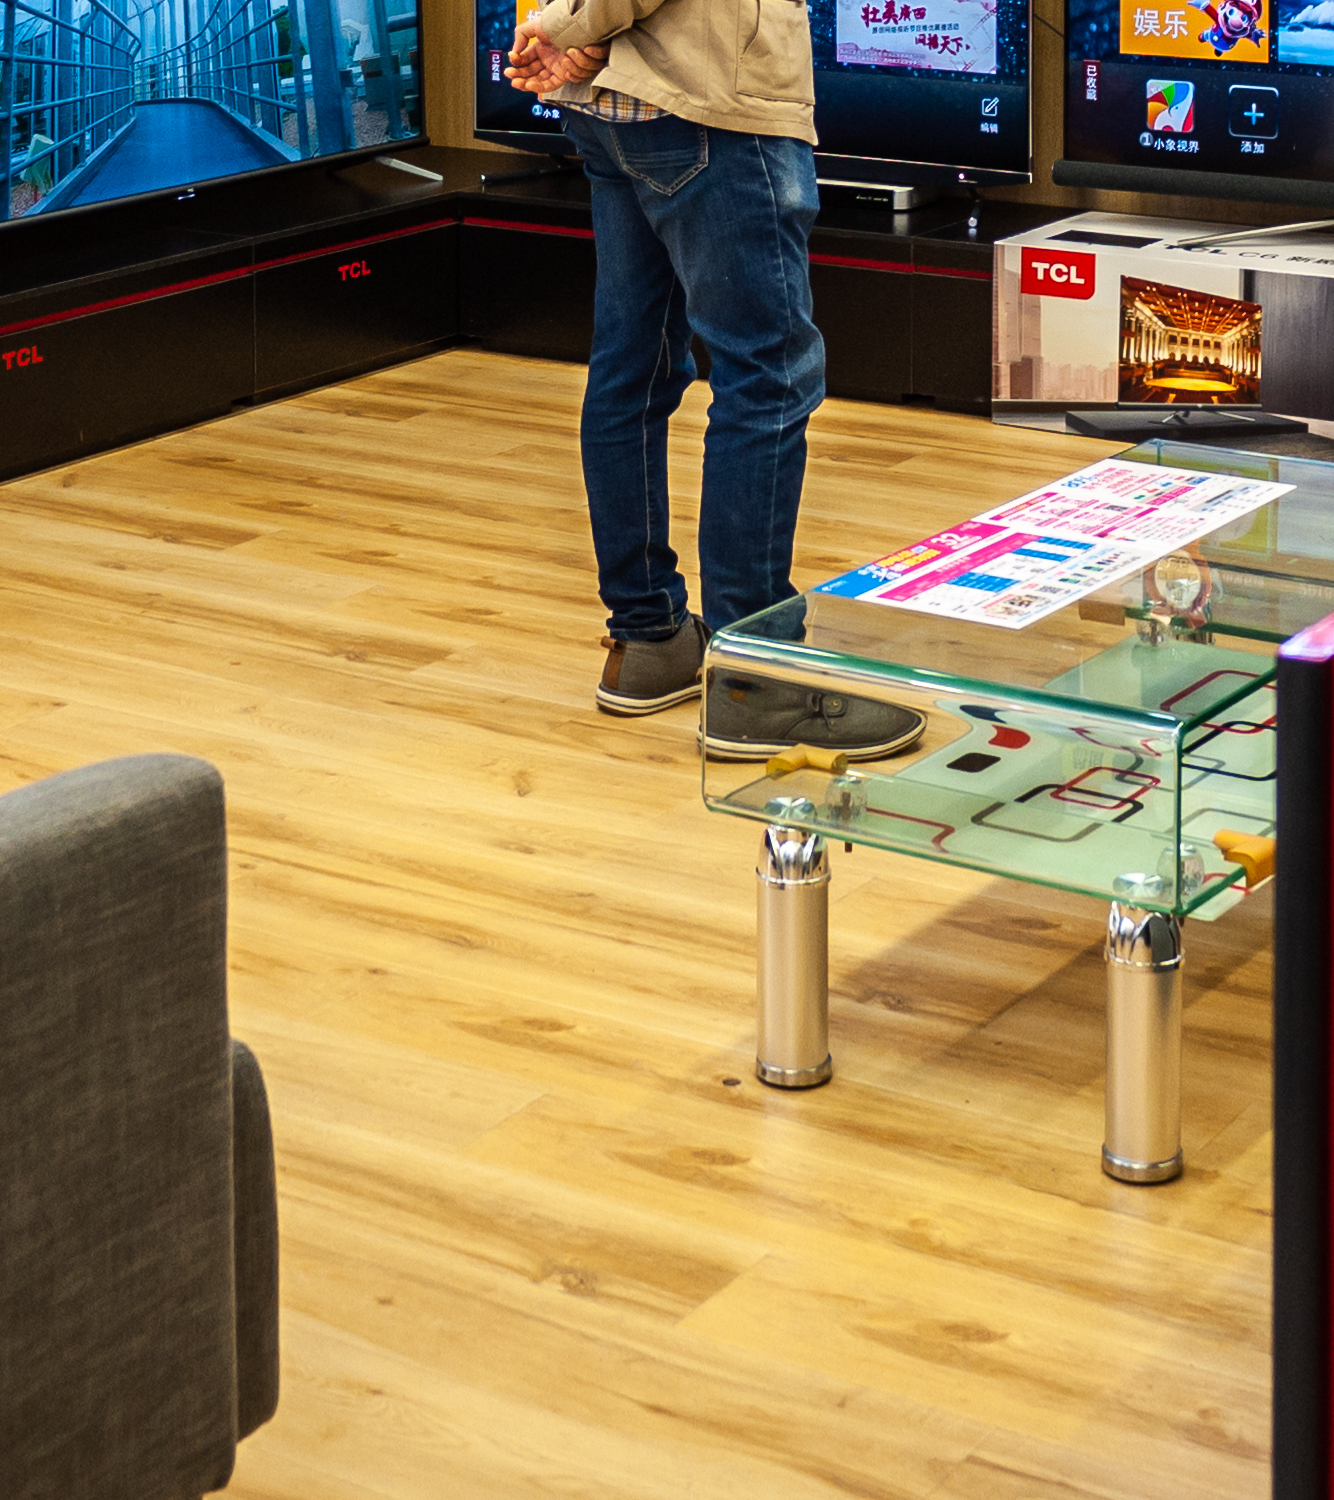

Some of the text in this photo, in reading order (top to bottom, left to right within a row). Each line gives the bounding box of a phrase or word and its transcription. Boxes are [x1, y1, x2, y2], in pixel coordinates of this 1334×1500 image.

[1134, 8, 1188, 38] 娱乐
[1241, 141, 1265, 153] 添加
[339, 261, 371, 280] TCL
[1031, 261, 1085, 284] TCL
[2, 346, 43, 370] TCL
